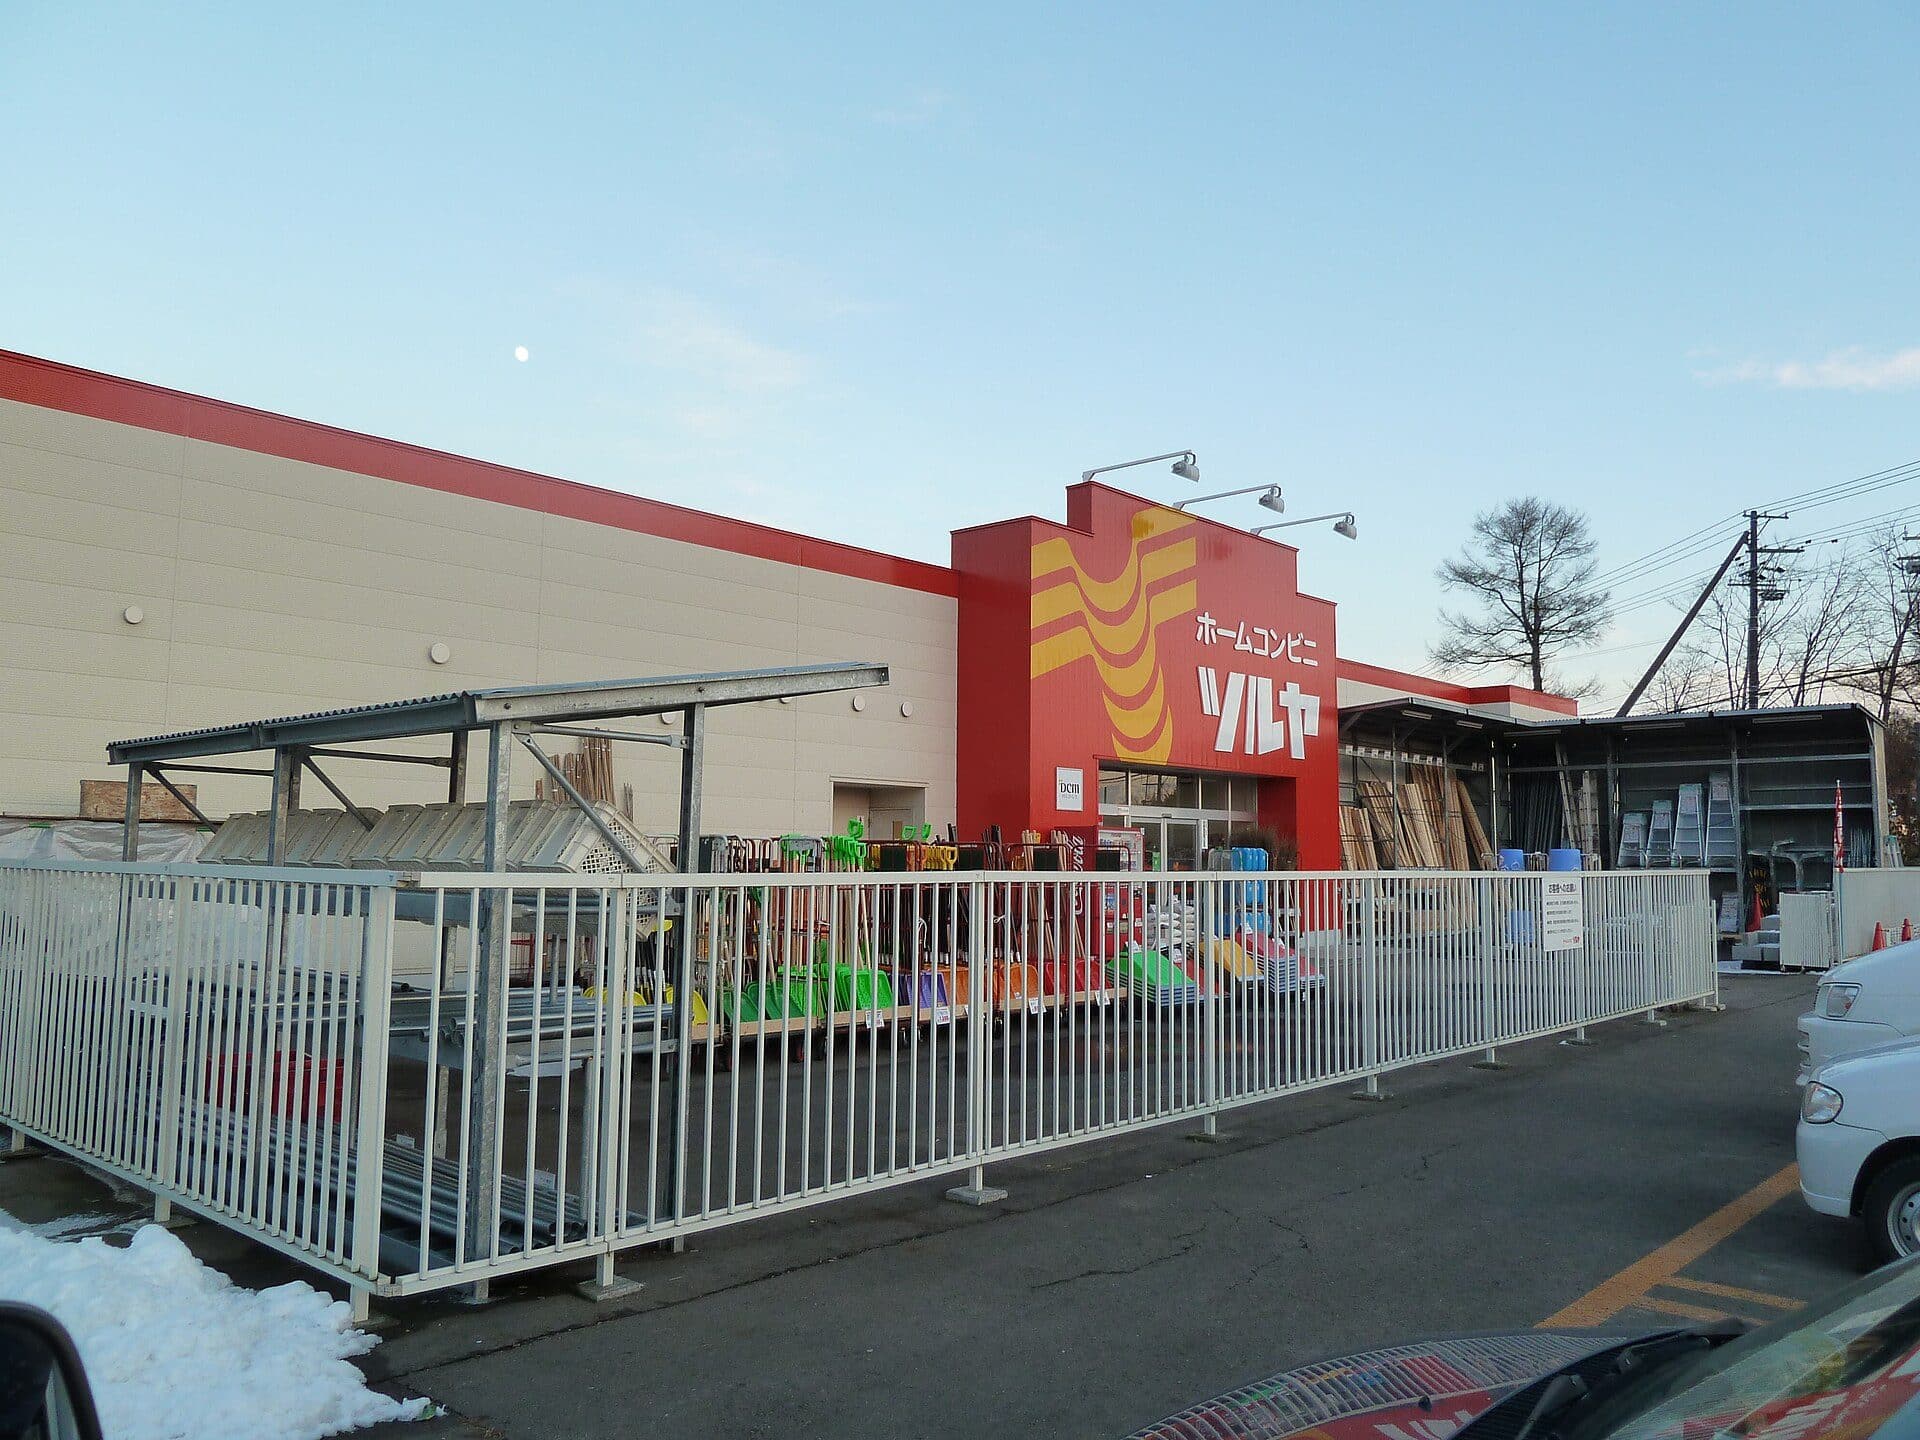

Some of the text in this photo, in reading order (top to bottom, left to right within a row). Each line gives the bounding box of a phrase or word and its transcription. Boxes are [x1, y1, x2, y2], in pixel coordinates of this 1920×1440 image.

[1196, 611, 1319, 667] ホームコンビニ
[1197, 666, 1321, 760] ツルヤ
